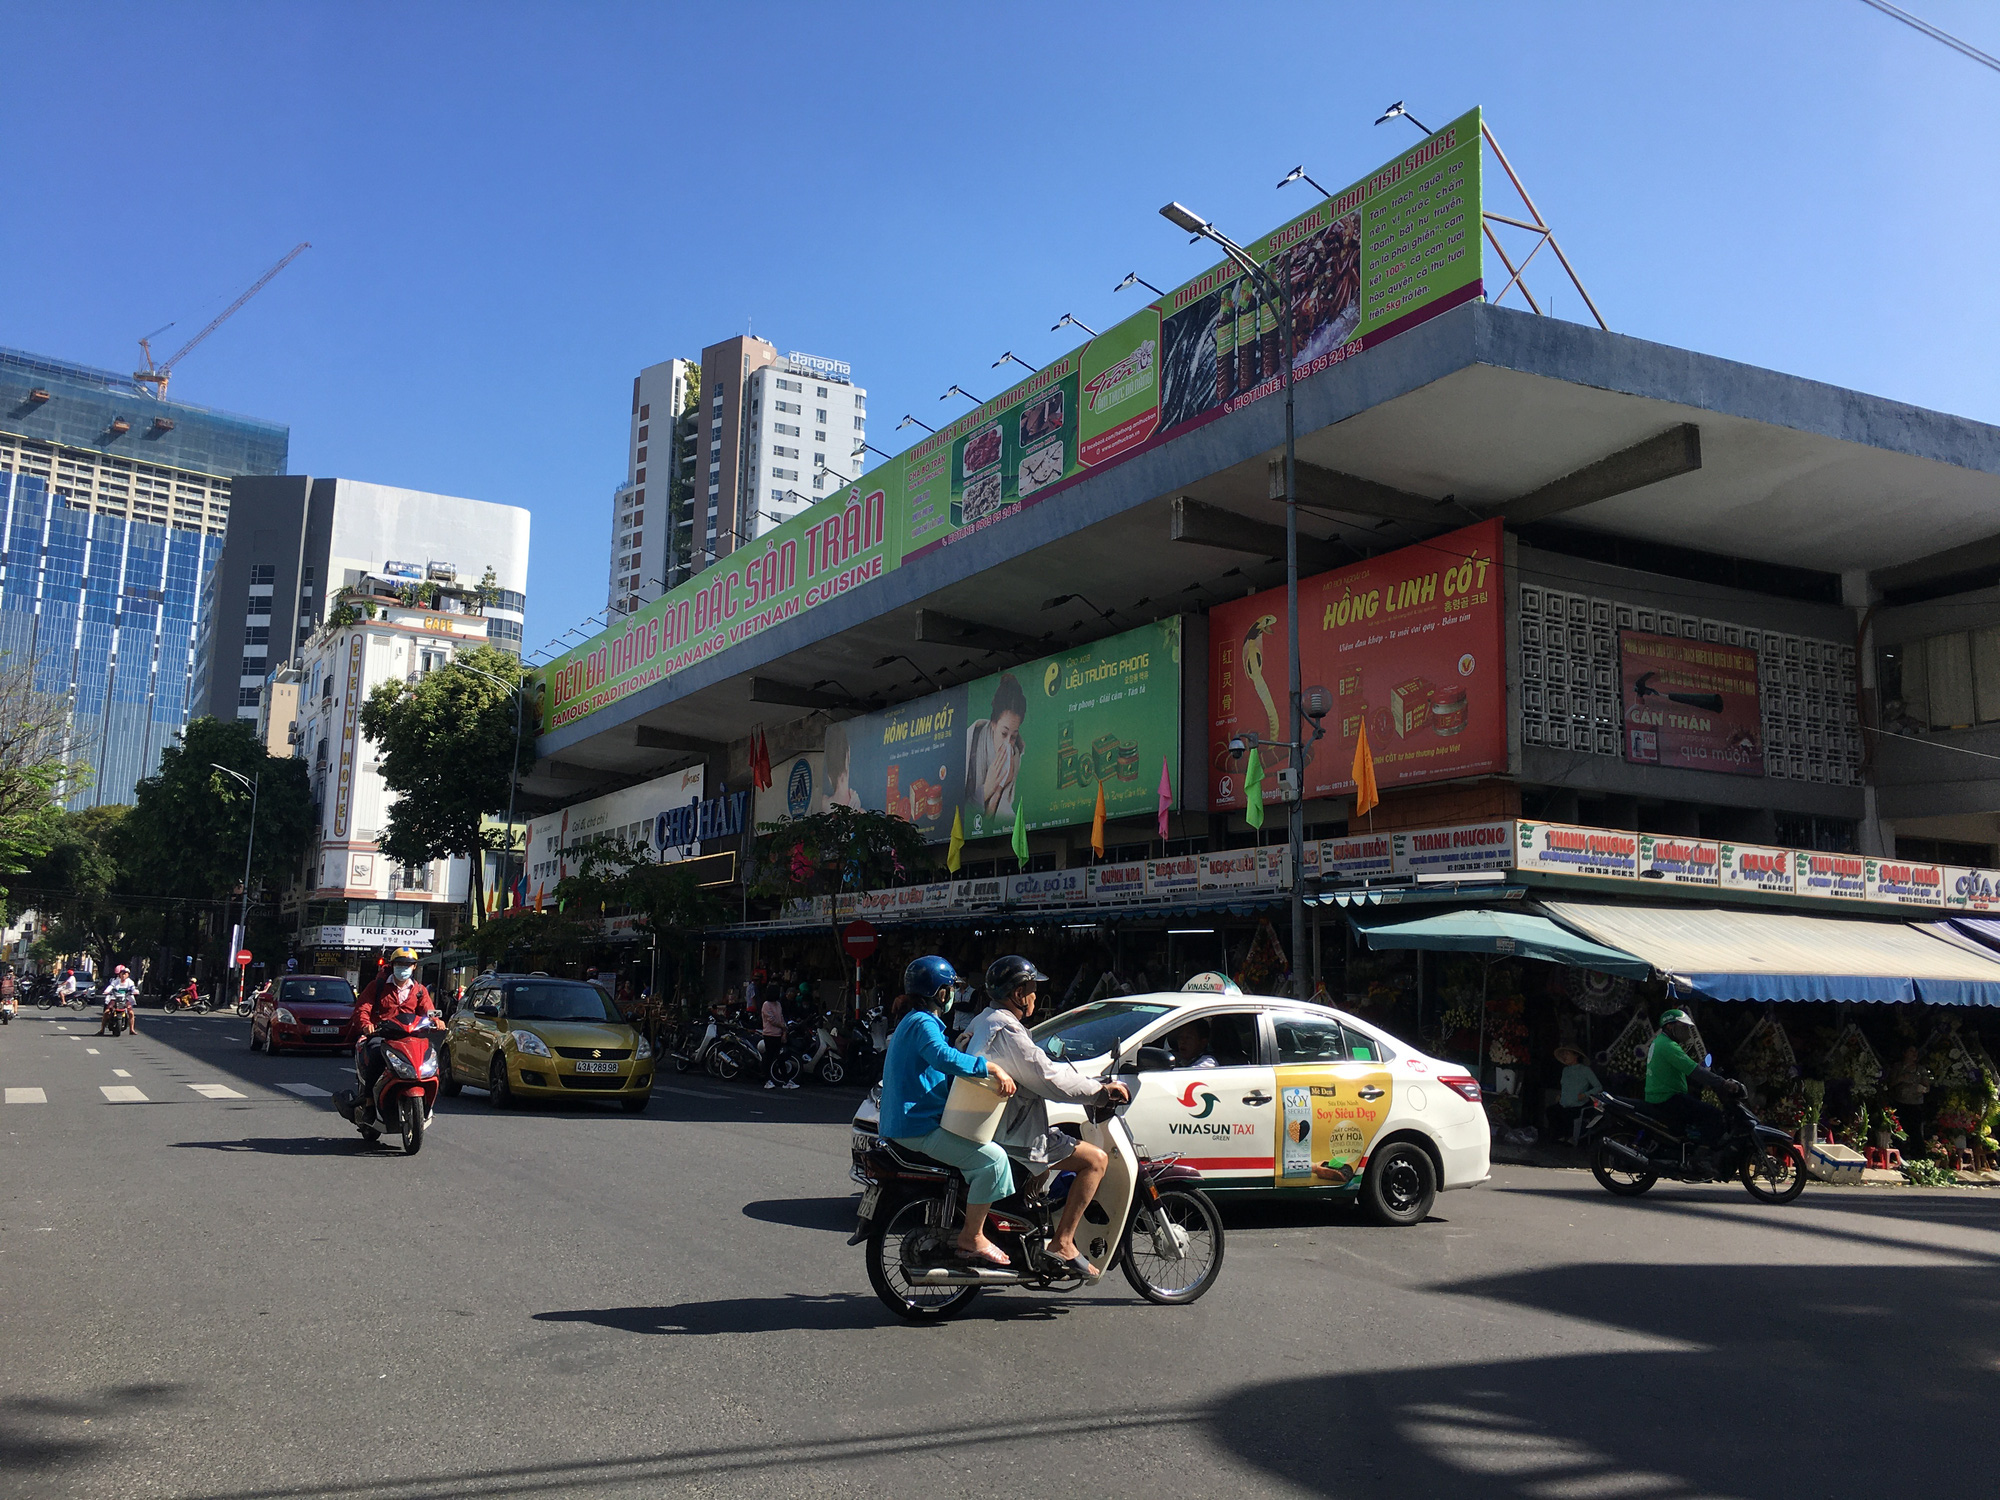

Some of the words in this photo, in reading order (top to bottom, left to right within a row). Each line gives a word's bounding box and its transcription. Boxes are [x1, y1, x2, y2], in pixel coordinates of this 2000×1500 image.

[1269, 210, 1325, 255] SPECIAL
[1328, 185, 1365, 220] TRAN
[1368, 162, 1402, 197] FISH
[1404, 128, 1457, 171] SAUCE
[1391, 190, 1414, 208] trách
[1418, 171, 1445, 193] người
[1448, 160, 1464, 175] tạo
[1369, 223, 1387, 237] nên
[1391, 214, 1401, 225] vị
[1405, 198, 1430, 217] nước
[1398, 221, 1414, 238] bất
[1418, 214, 1430, 227] hư
[1369, 272, 1383, 287] kết
[1385, 261, 1407, 278] 100%
[1410, 251, 1421, 266] cá
[1447, 228, 1465, 246] tươi
[1381, 252, 1390, 264] là
[1369, 288, 1385, 304] hòa
[1387, 275, 1413, 296] quyện
[1416, 265, 1428, 280] cá
[1430, 257, 1445, 273] thu
[1447, 245, 1465, 263] tươi
[1369, 304, 1386, 321] trên
[1386, 299, 1401, 313] 5kg
[790, 351, 850, 375] danapha
[1233, 378, 1280, 411] HOTLINE:
[1311, 356, 1328, 374] 95
[1329, 348, 1346, 367] 24
[1346, 338, 1364, 357] 24
[553, 652, 584, 709] ĐẾN
[586, 642, 607, 694] ĐÀ
[611, 617, 659, 681] NẴNG
[662, 599, 691, 653] ĂN
[694, 571, 740, 641] ĐẶC
[744, 539, 798, 611] SẢN
[804, 487, 886, 581] TRẦN
[1323, 586, 1380, 631] HỒNG
[1385, 572, 1438, 613] LINH
[1443, 548, 1491, 598] CỐT
[424, 616, 454, 632] CAFE
[551, 699, 590, 730] FAMOUS
[591, 666, 662, 710] TRADITIONAL
[665, 633, 725, 677] DANANG
[729, 595, 801, 646] VIETNAM
[804, 553, 884, 609] CUISINE
[1065, 668, 1084, 690] LIỆU
[1119, 653, 1149, 675] PHONG
[345, 643, 360, 741] EVELYN
[883, 716, 908, 746] HỒNG
[910, 714, 933, 738] LINH
[934, 701, 954, 732] CỐT
[1668, 713, 1711, 733] THẬN
[1681, 744, 1708, 761] quá
[335, 751, 351, 834] HOTEL
[655, 795, 699, 857] CHỢ
[698, 781, 749, 841] HÀN
[1412, 833, 1450, 852] THANH
[1453, 827, 1506, 848] PHƯƠNG
[1548, 830, 1586, 850] THANH
[1588, 834, 1636, 855] PHƯƠNG
[1742, 850, 1789, 873] HUẾ
[1810, 856, 1832, 873] THU
[1833, 858, 1862, 878] HẠNH
[1880, 864, 1911, 885] ĐẠM
[1955, 867, 1993, 896] CỬA
[360, 928, 388, 936] TRUE
[390, 928, 419, 936] SHOP
[1187, 983, 1214, 991] VINASUN
[1286, 1095, 1309, 1108] SOY
[1317, 1108, 1334, 1123] Soy
[1335, 1108, 1354, 1119] Siêu
[1356, 1107, 1376, 1122] Đẹp
[1169, 1124, 1230, 1135] VINASUN
[1232, 1123, 1255, 1135] TAXI
[1330, 1133, 1344, 1143] OXY
